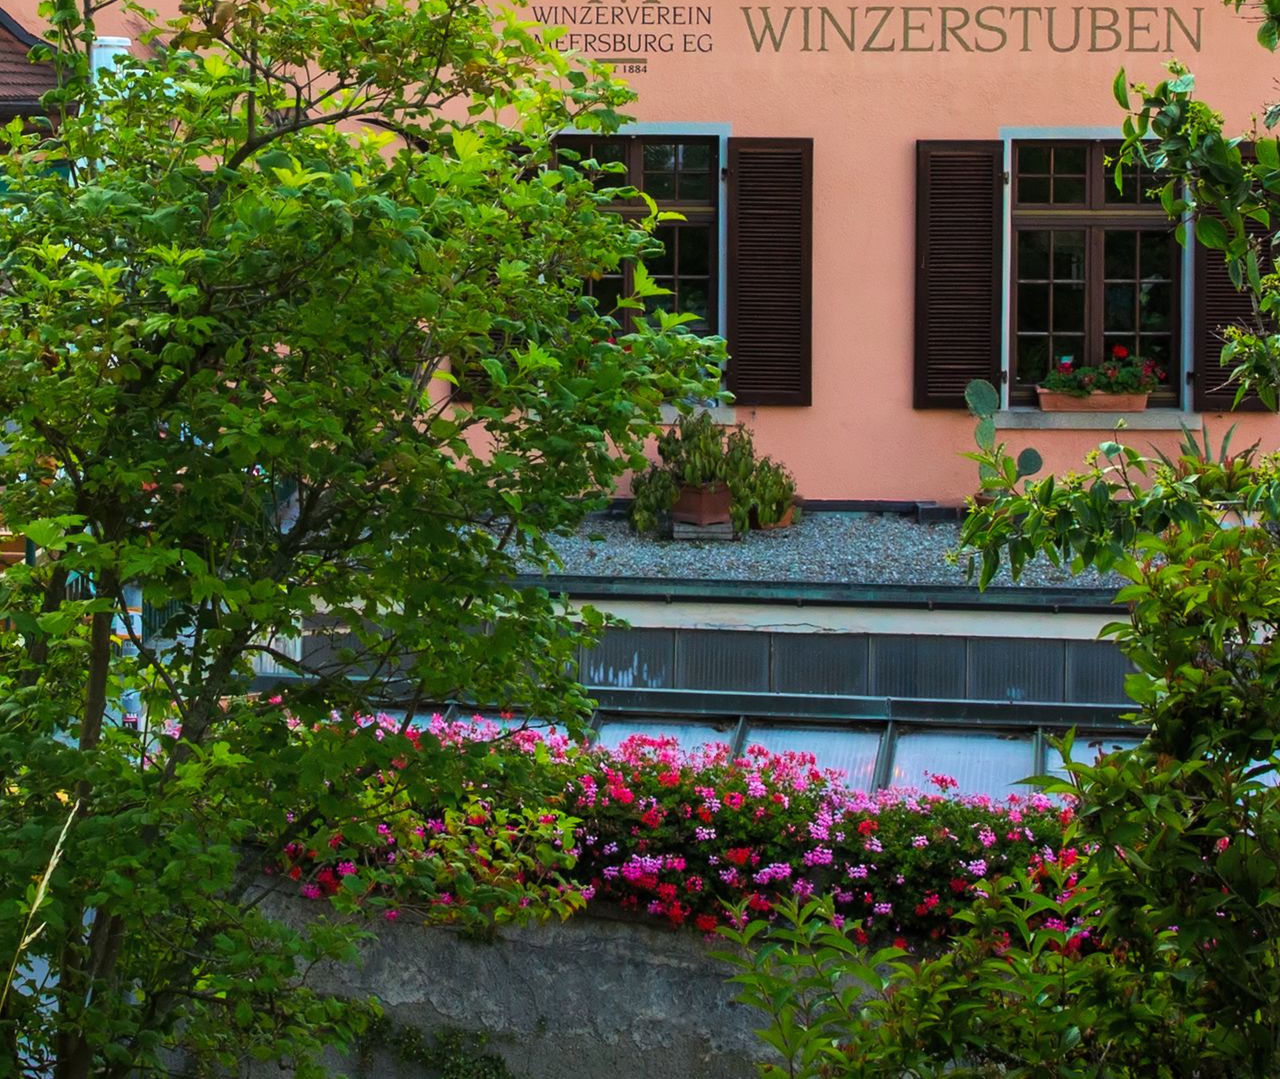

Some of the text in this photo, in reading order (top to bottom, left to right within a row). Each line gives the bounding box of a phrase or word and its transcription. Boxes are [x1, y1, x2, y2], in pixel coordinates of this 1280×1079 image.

[532, 6, 712, 25] WINZERVEREIN
[739, 5, 1206, 53] WINZERSTUBEN
[683, 33, 713, 53] EG
[623, 65, 648, 74] 1884
